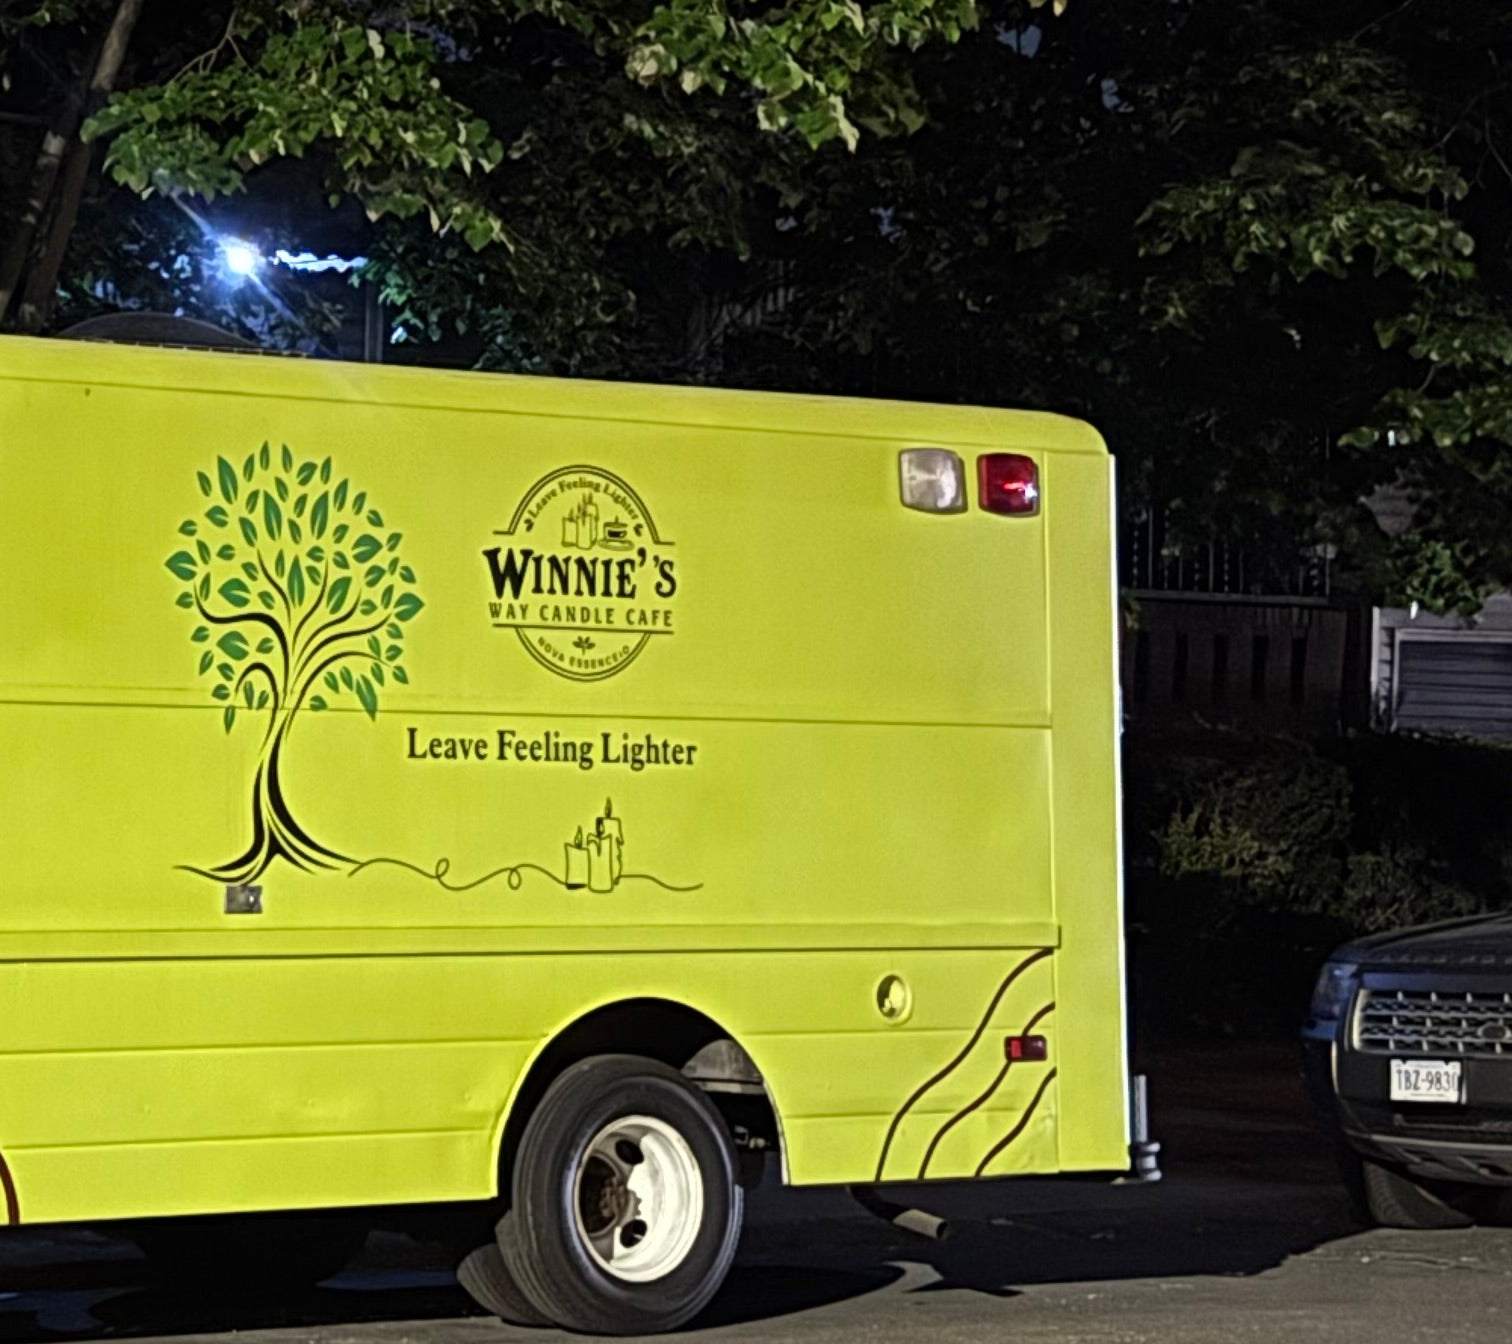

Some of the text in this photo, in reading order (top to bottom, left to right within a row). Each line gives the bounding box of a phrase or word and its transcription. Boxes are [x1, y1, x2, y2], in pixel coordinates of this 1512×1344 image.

[558, 476, 600, 493] Feeling
[603, 482, 639, 520] Lighter
[489, 602, 673, 627] WAY CANDLE CAFE
[407, 727, 697, 771] Leave Feeling Lighter
